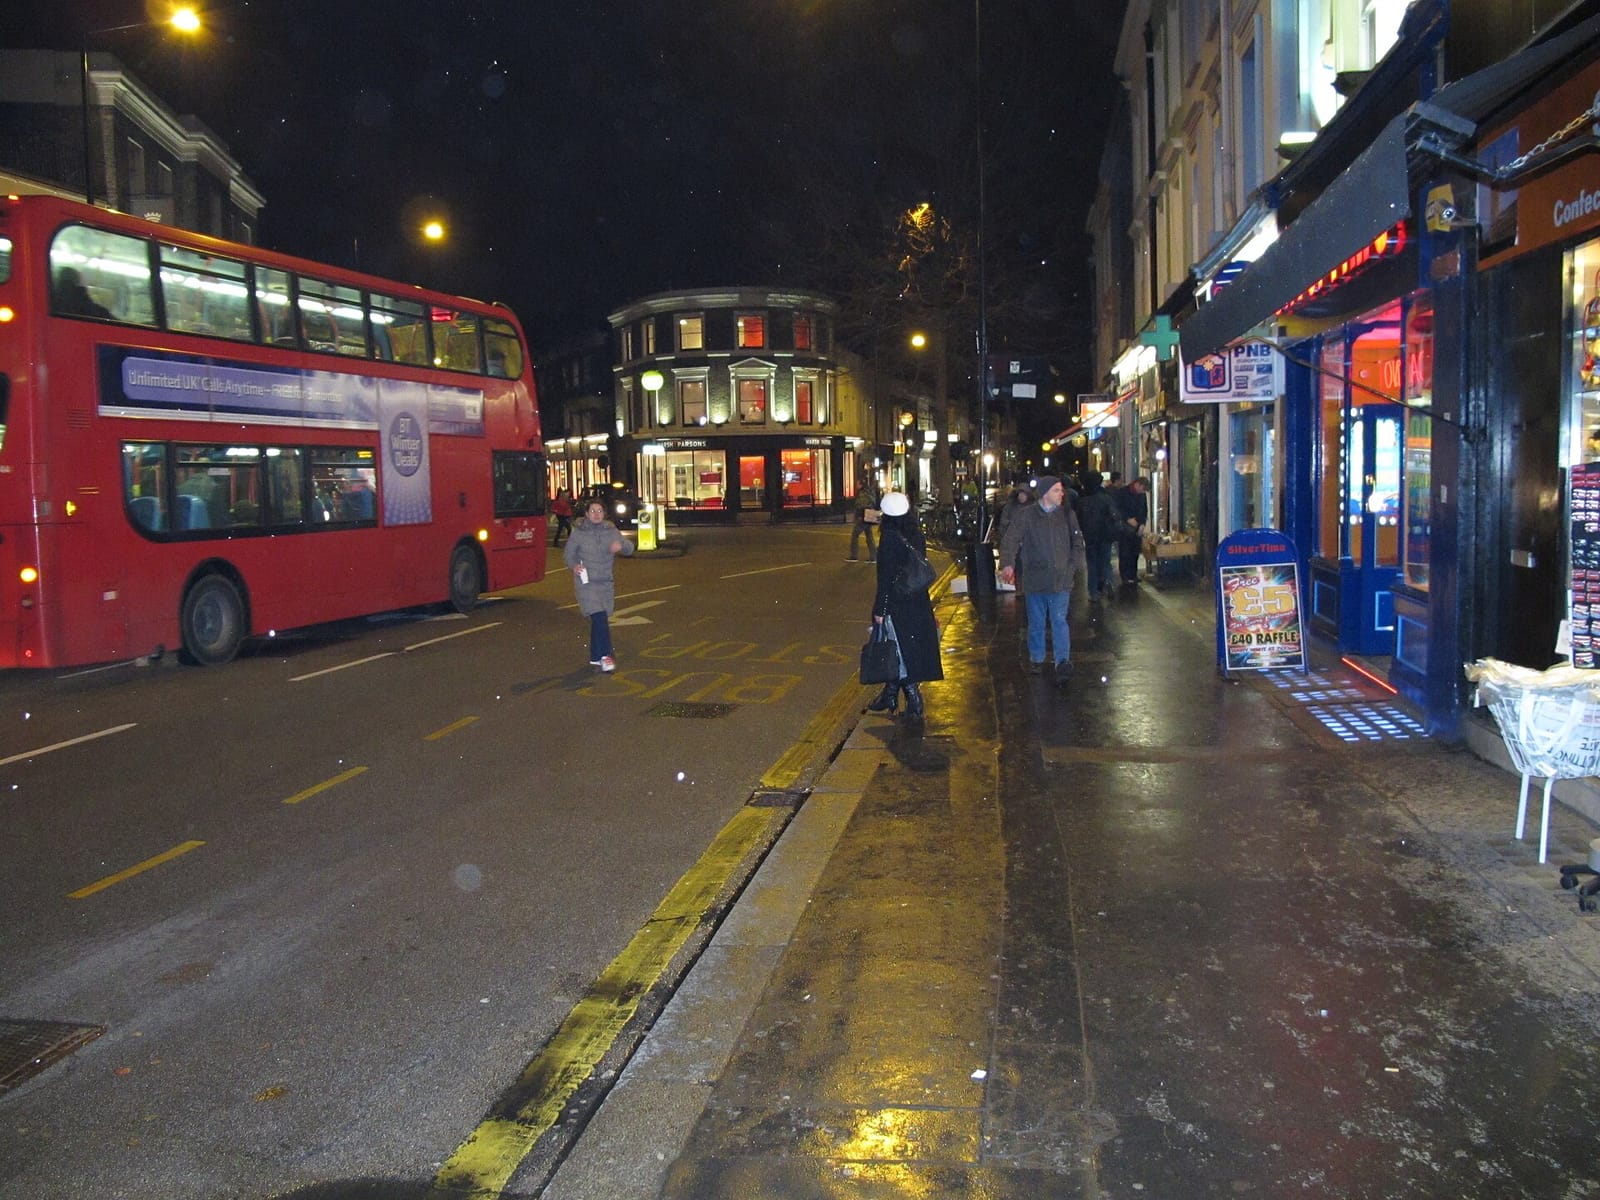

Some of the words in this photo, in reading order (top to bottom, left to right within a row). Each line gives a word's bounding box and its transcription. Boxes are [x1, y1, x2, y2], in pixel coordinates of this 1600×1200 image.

[1553, 188, 1600, 227] Confec
[1234, 343, 1271, 358] PNB
[128, 368, 181, 390] Unlimited
[201, 377, 226, 393] Calls
[226, 380, 264, 398] Anytime
[399, 417, 411, 433] BT
[391, 434, 420, 451] Winter
[677, 440, 707, 448] PARSONS
[394, 451, 418, 466] Deals
[1228, 577, 1259, 591] Free
[1230, 584, 1296, 618] £5
[1231, 633, 1252, 645] £40
[1256, 631, 1297, 645] RAFFLE
[576, 669, 803, 703] BUS
